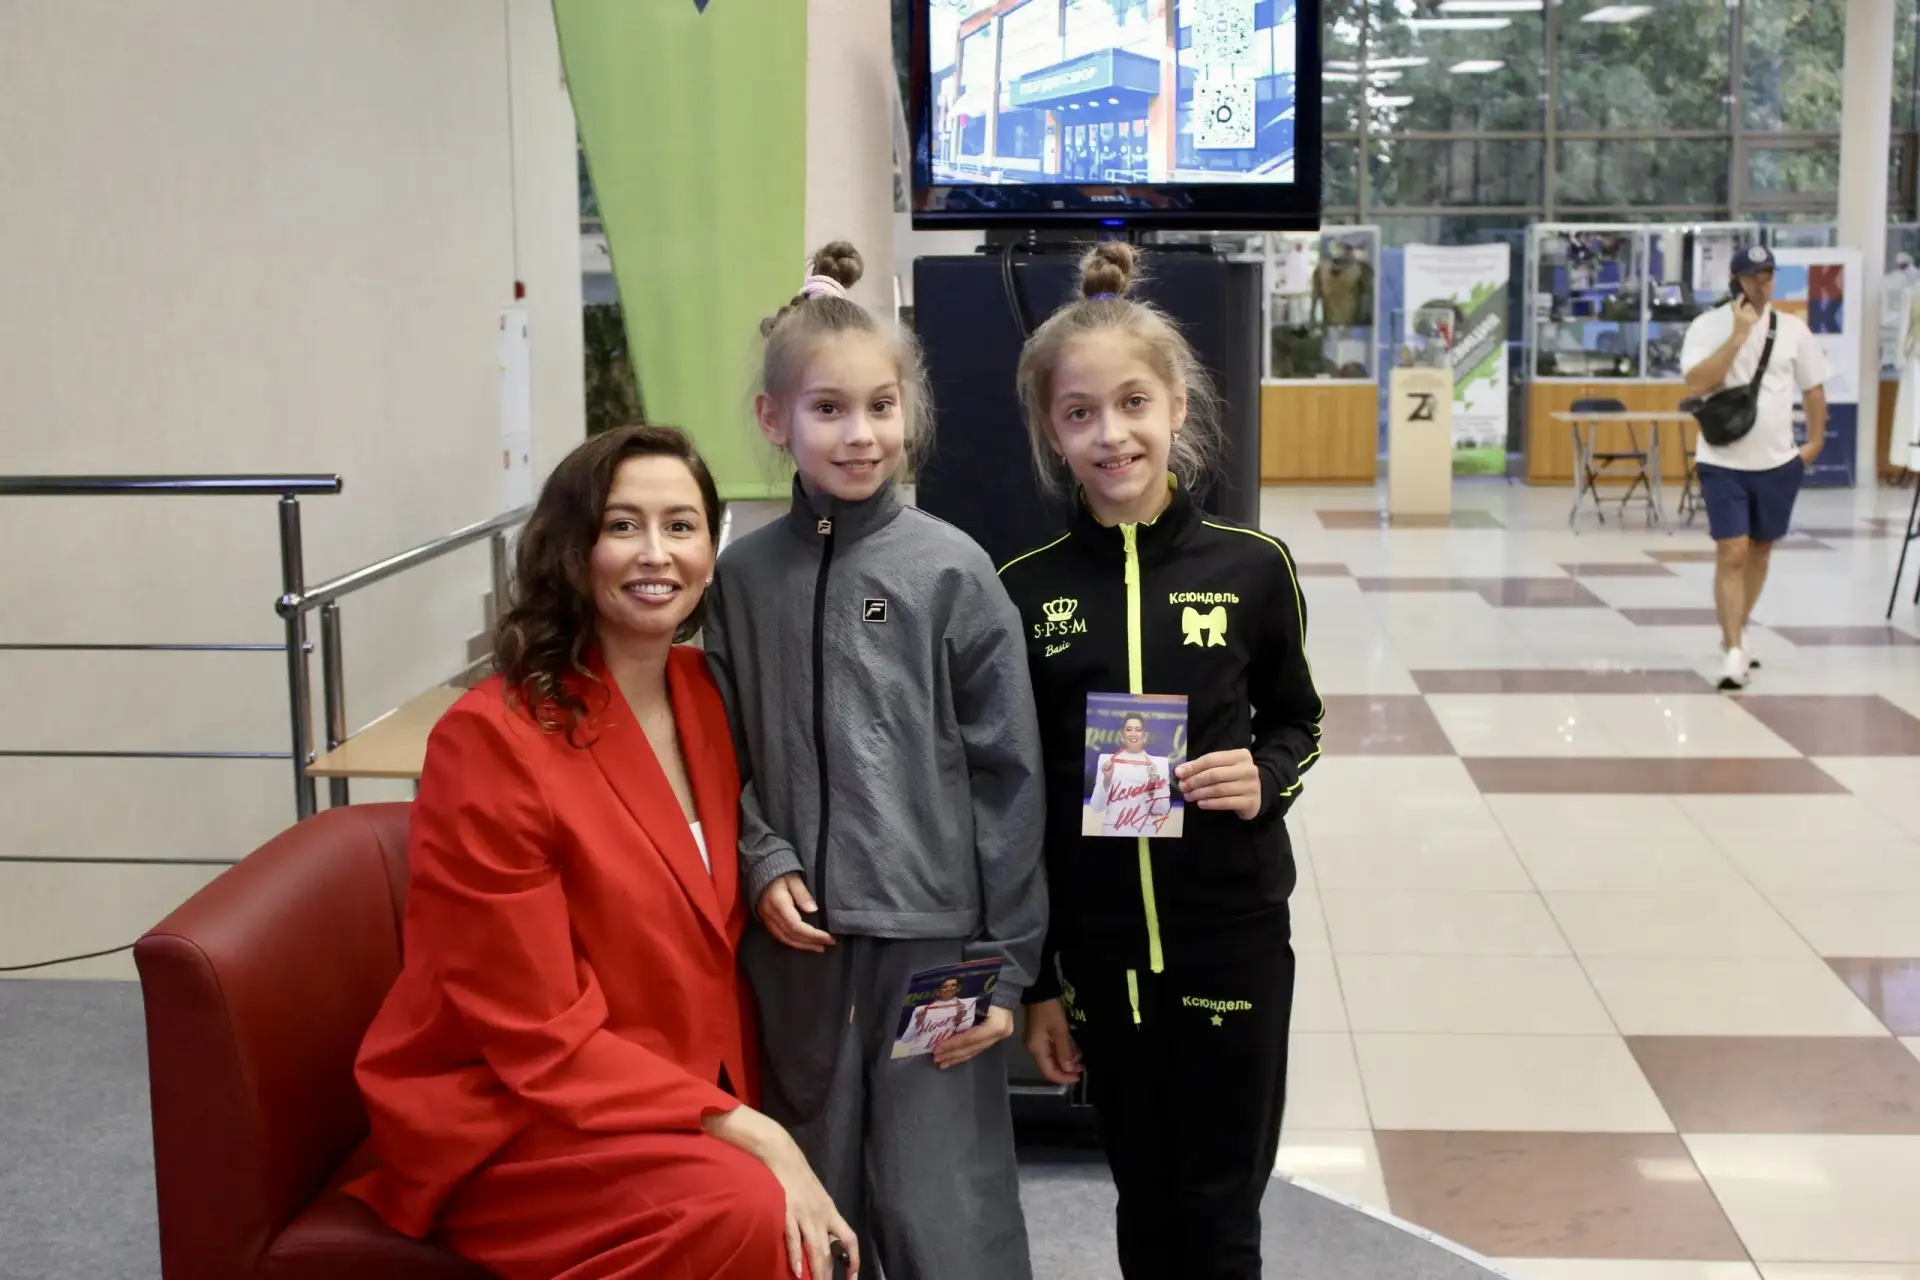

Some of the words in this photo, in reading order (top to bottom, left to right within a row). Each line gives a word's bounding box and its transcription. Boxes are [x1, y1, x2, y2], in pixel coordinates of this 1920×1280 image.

[1169, 591, 1240, 605] Ксюндель
[1044, 640, 1072, 658] Basic
[1181, 995, 1253, 1013] Ксюндель
